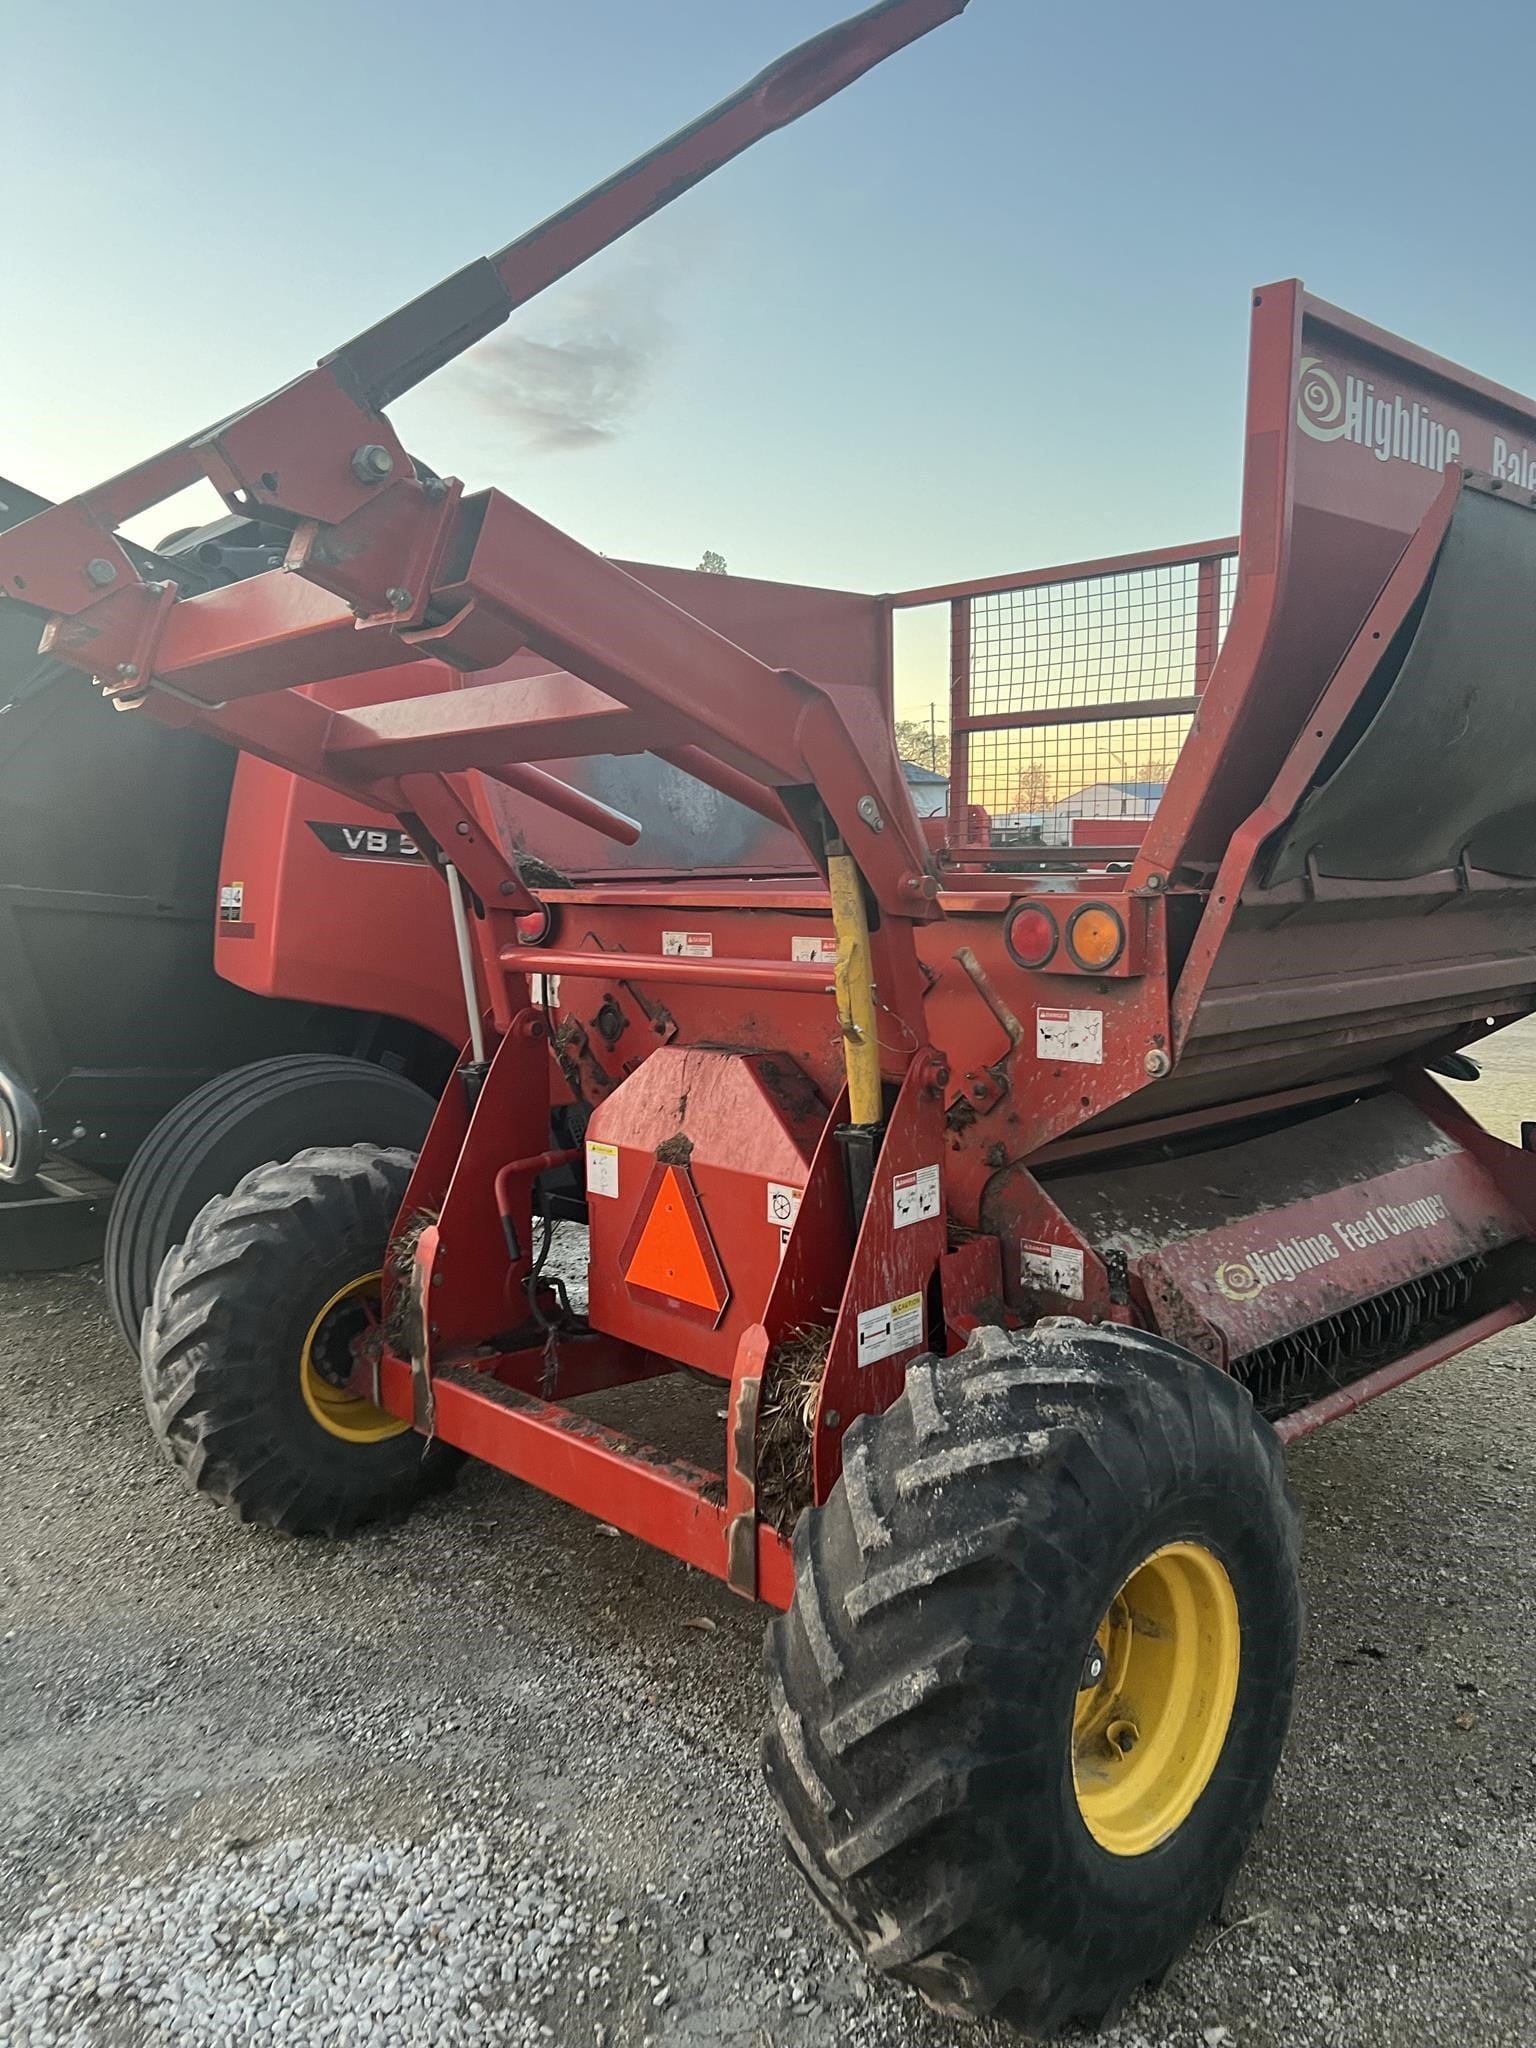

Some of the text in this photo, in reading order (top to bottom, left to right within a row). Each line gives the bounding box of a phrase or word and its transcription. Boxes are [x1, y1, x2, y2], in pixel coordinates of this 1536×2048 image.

[1344, 376, 1460, 472] Highline
[342, 828, 387, 852] VB
[1246, 1233, 1340, 1287] Highline
[1331, 1211, 1389, 1252] Feed
[897, 1296, 920, 1311] CAUTION
